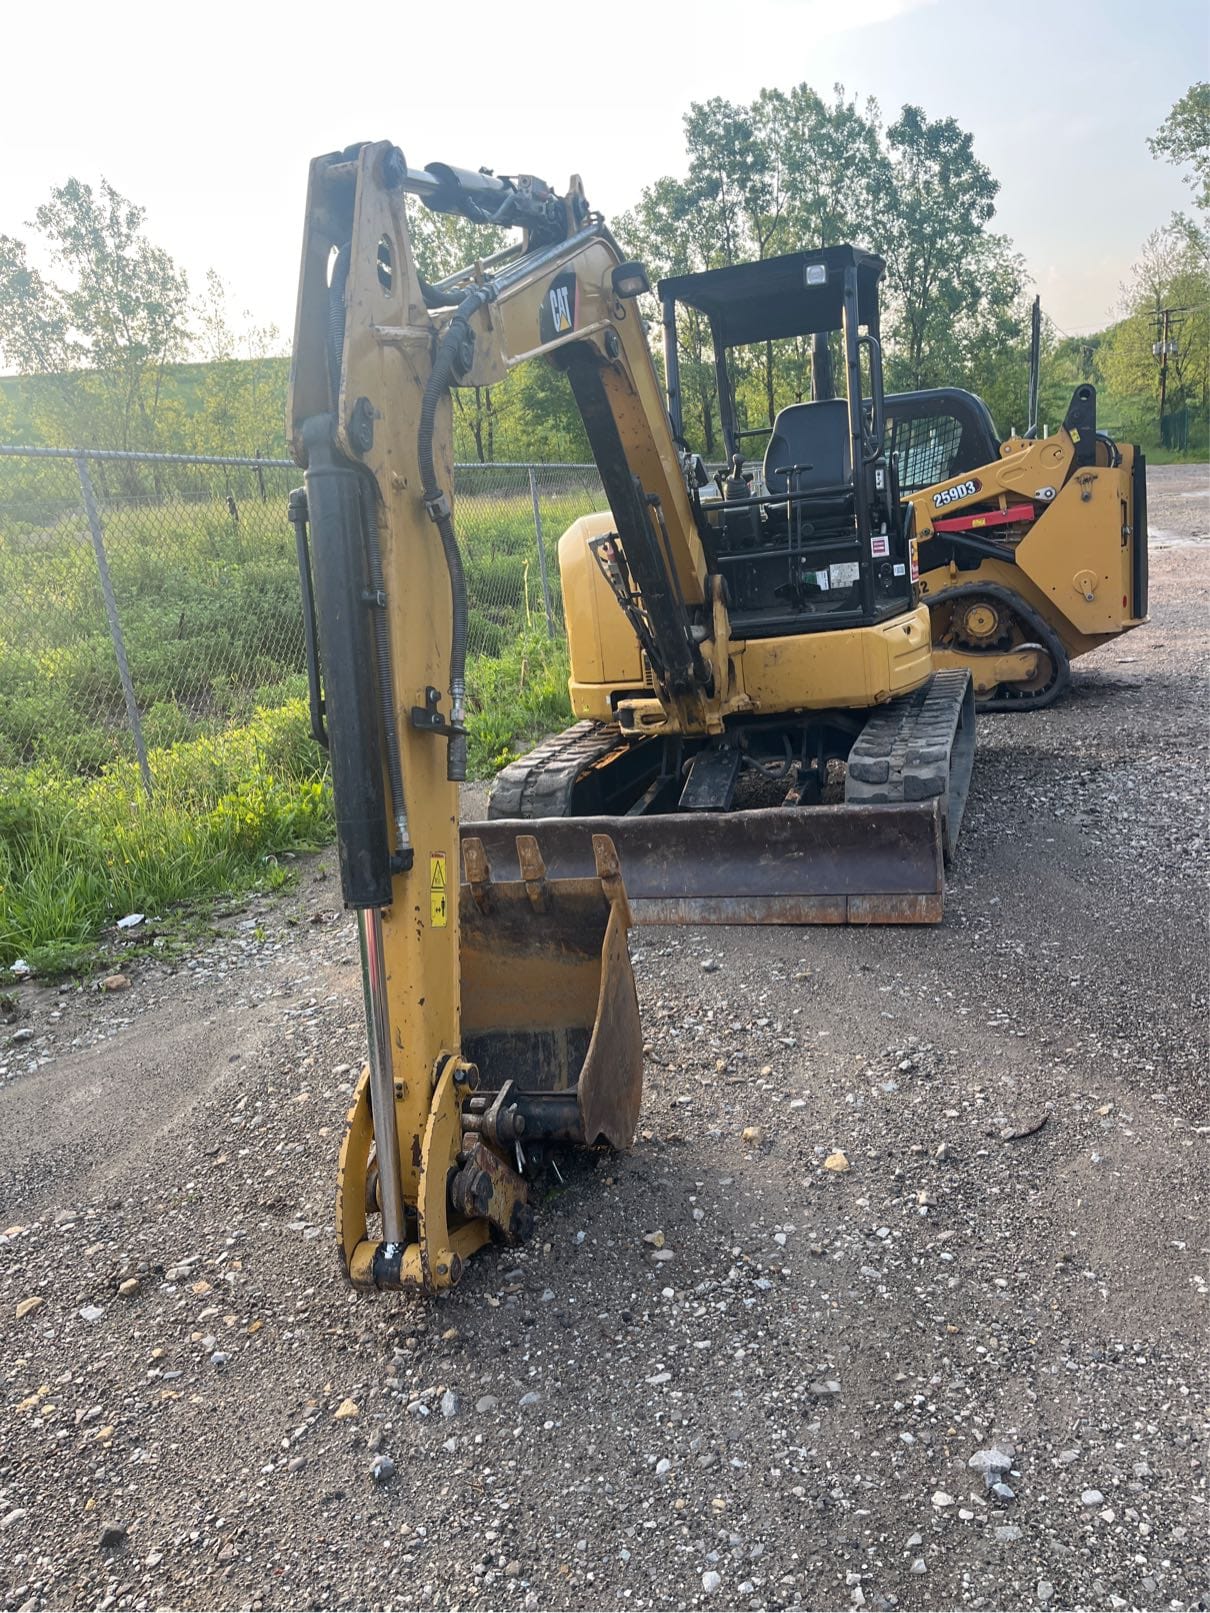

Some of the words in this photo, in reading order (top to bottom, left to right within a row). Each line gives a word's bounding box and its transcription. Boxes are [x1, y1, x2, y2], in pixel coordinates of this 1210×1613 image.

[549, 286, 572, 333] CAT
[933, 480, 976, 508] 259D3
[918, 580, 930, 594] 2
